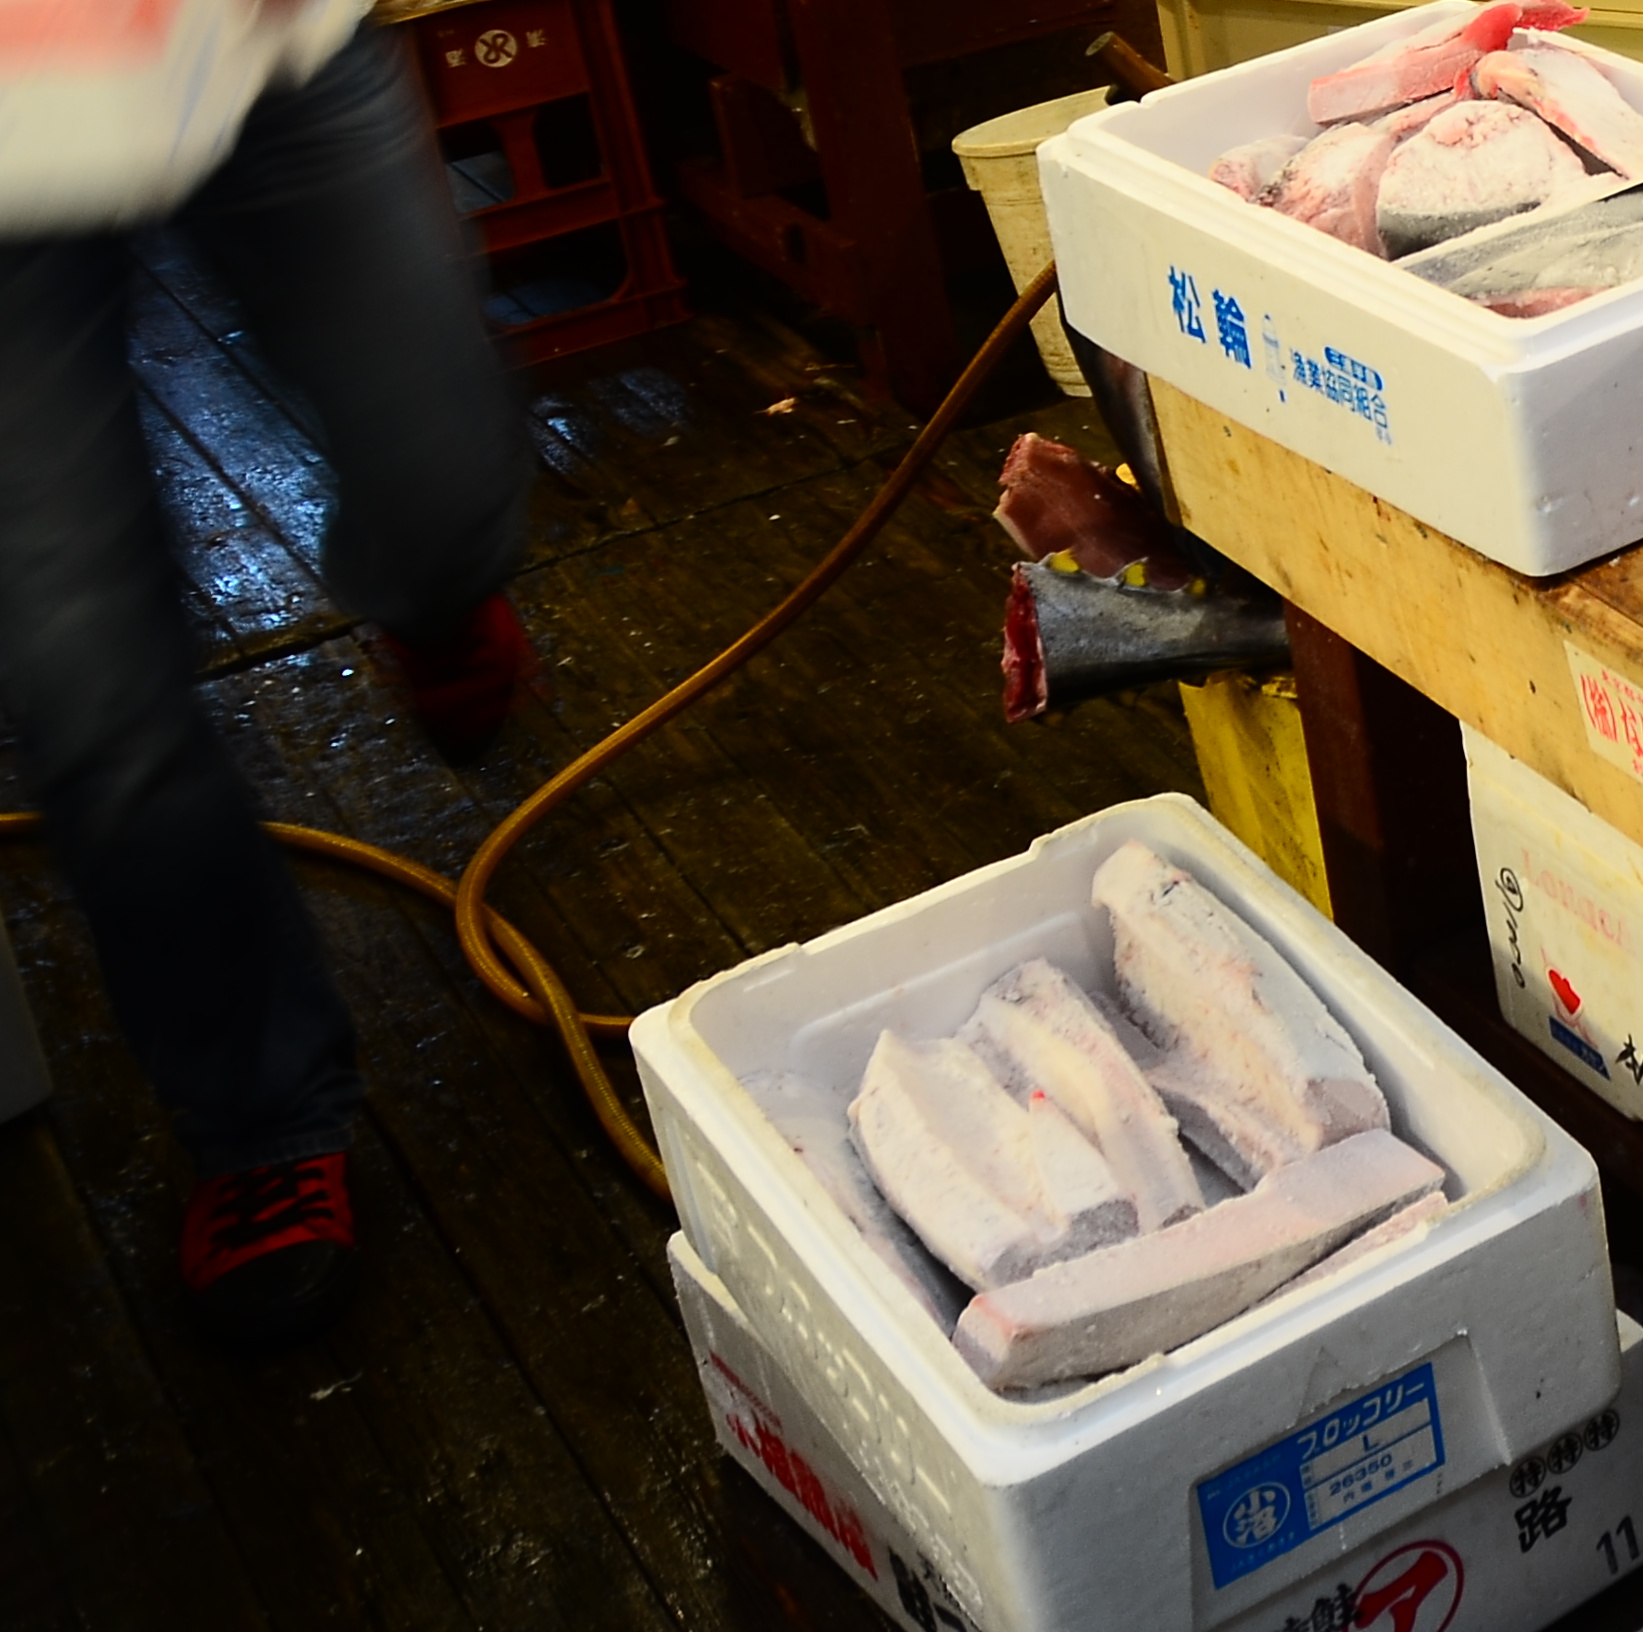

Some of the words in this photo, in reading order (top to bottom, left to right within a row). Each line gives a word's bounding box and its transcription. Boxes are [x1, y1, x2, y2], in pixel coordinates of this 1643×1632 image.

[1167, 264, 1253, 369] 松輪
[1290, 347, 1389, 429] 漁業協同組合
[1329, 1452, 1394, 1496] 26350
[1363, 1433, 1381, 1452] L
[1513, 1485, 1572, 1554] 路
[1596, 1514, 1641, 1576] 11
